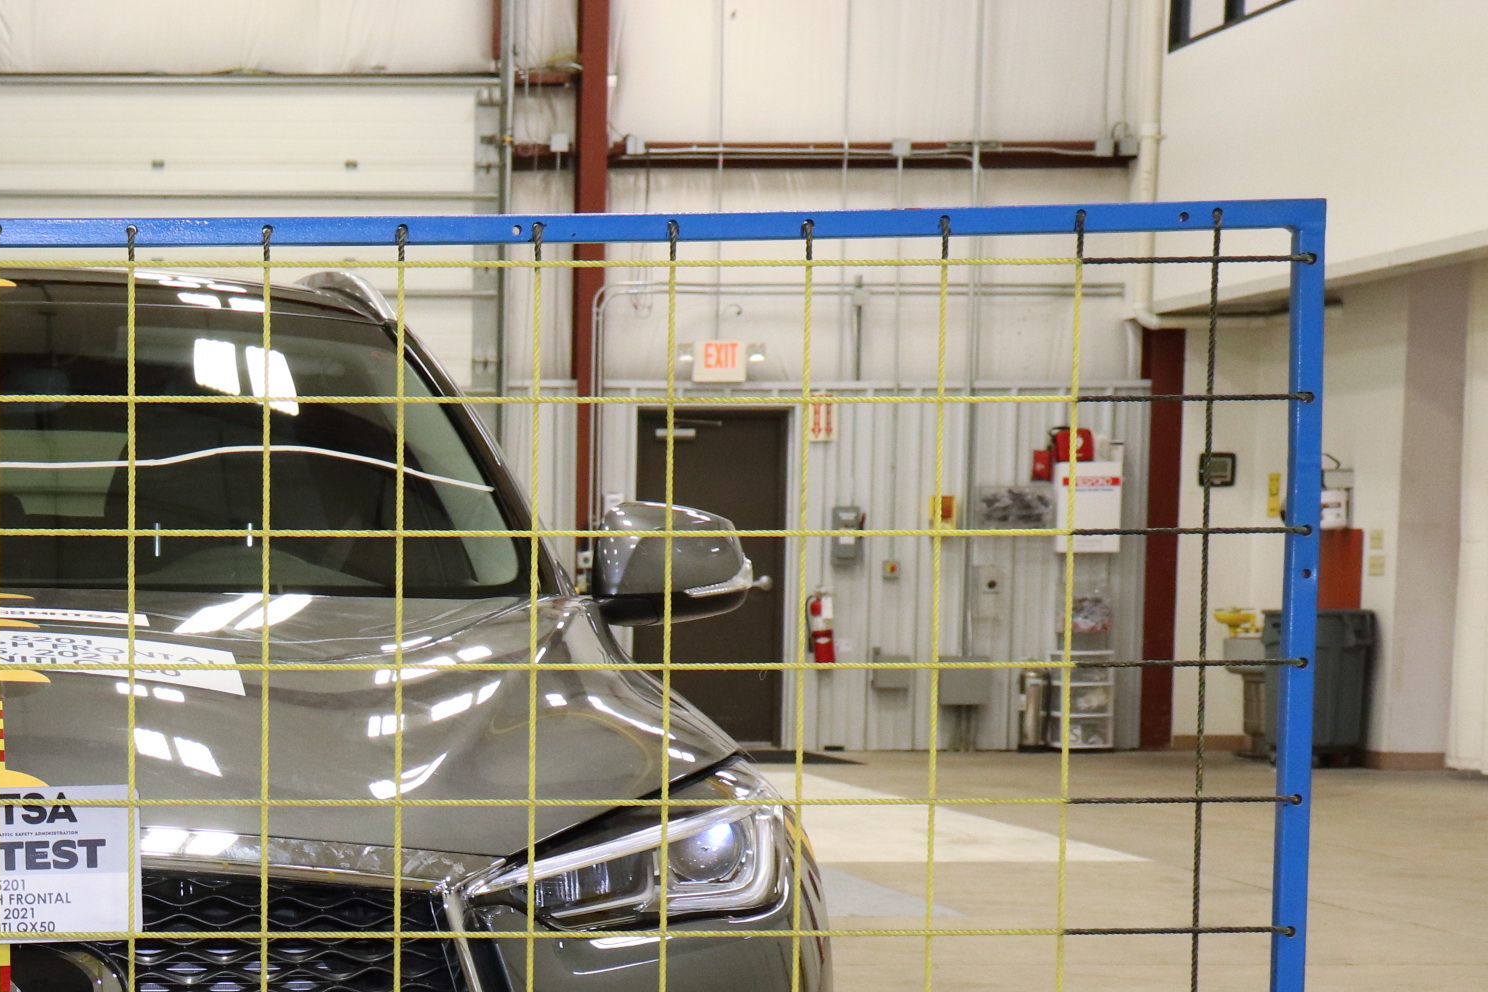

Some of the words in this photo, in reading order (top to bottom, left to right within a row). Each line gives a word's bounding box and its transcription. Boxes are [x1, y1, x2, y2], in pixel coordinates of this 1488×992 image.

[704, 342, 739, 369] EXIT
[32, 649, 120, 661] 2021
[9, 892, 72, 905] FRONTAL
[3, 907, 35, 920] 2021
[16, 920, 56, 933] QX50
